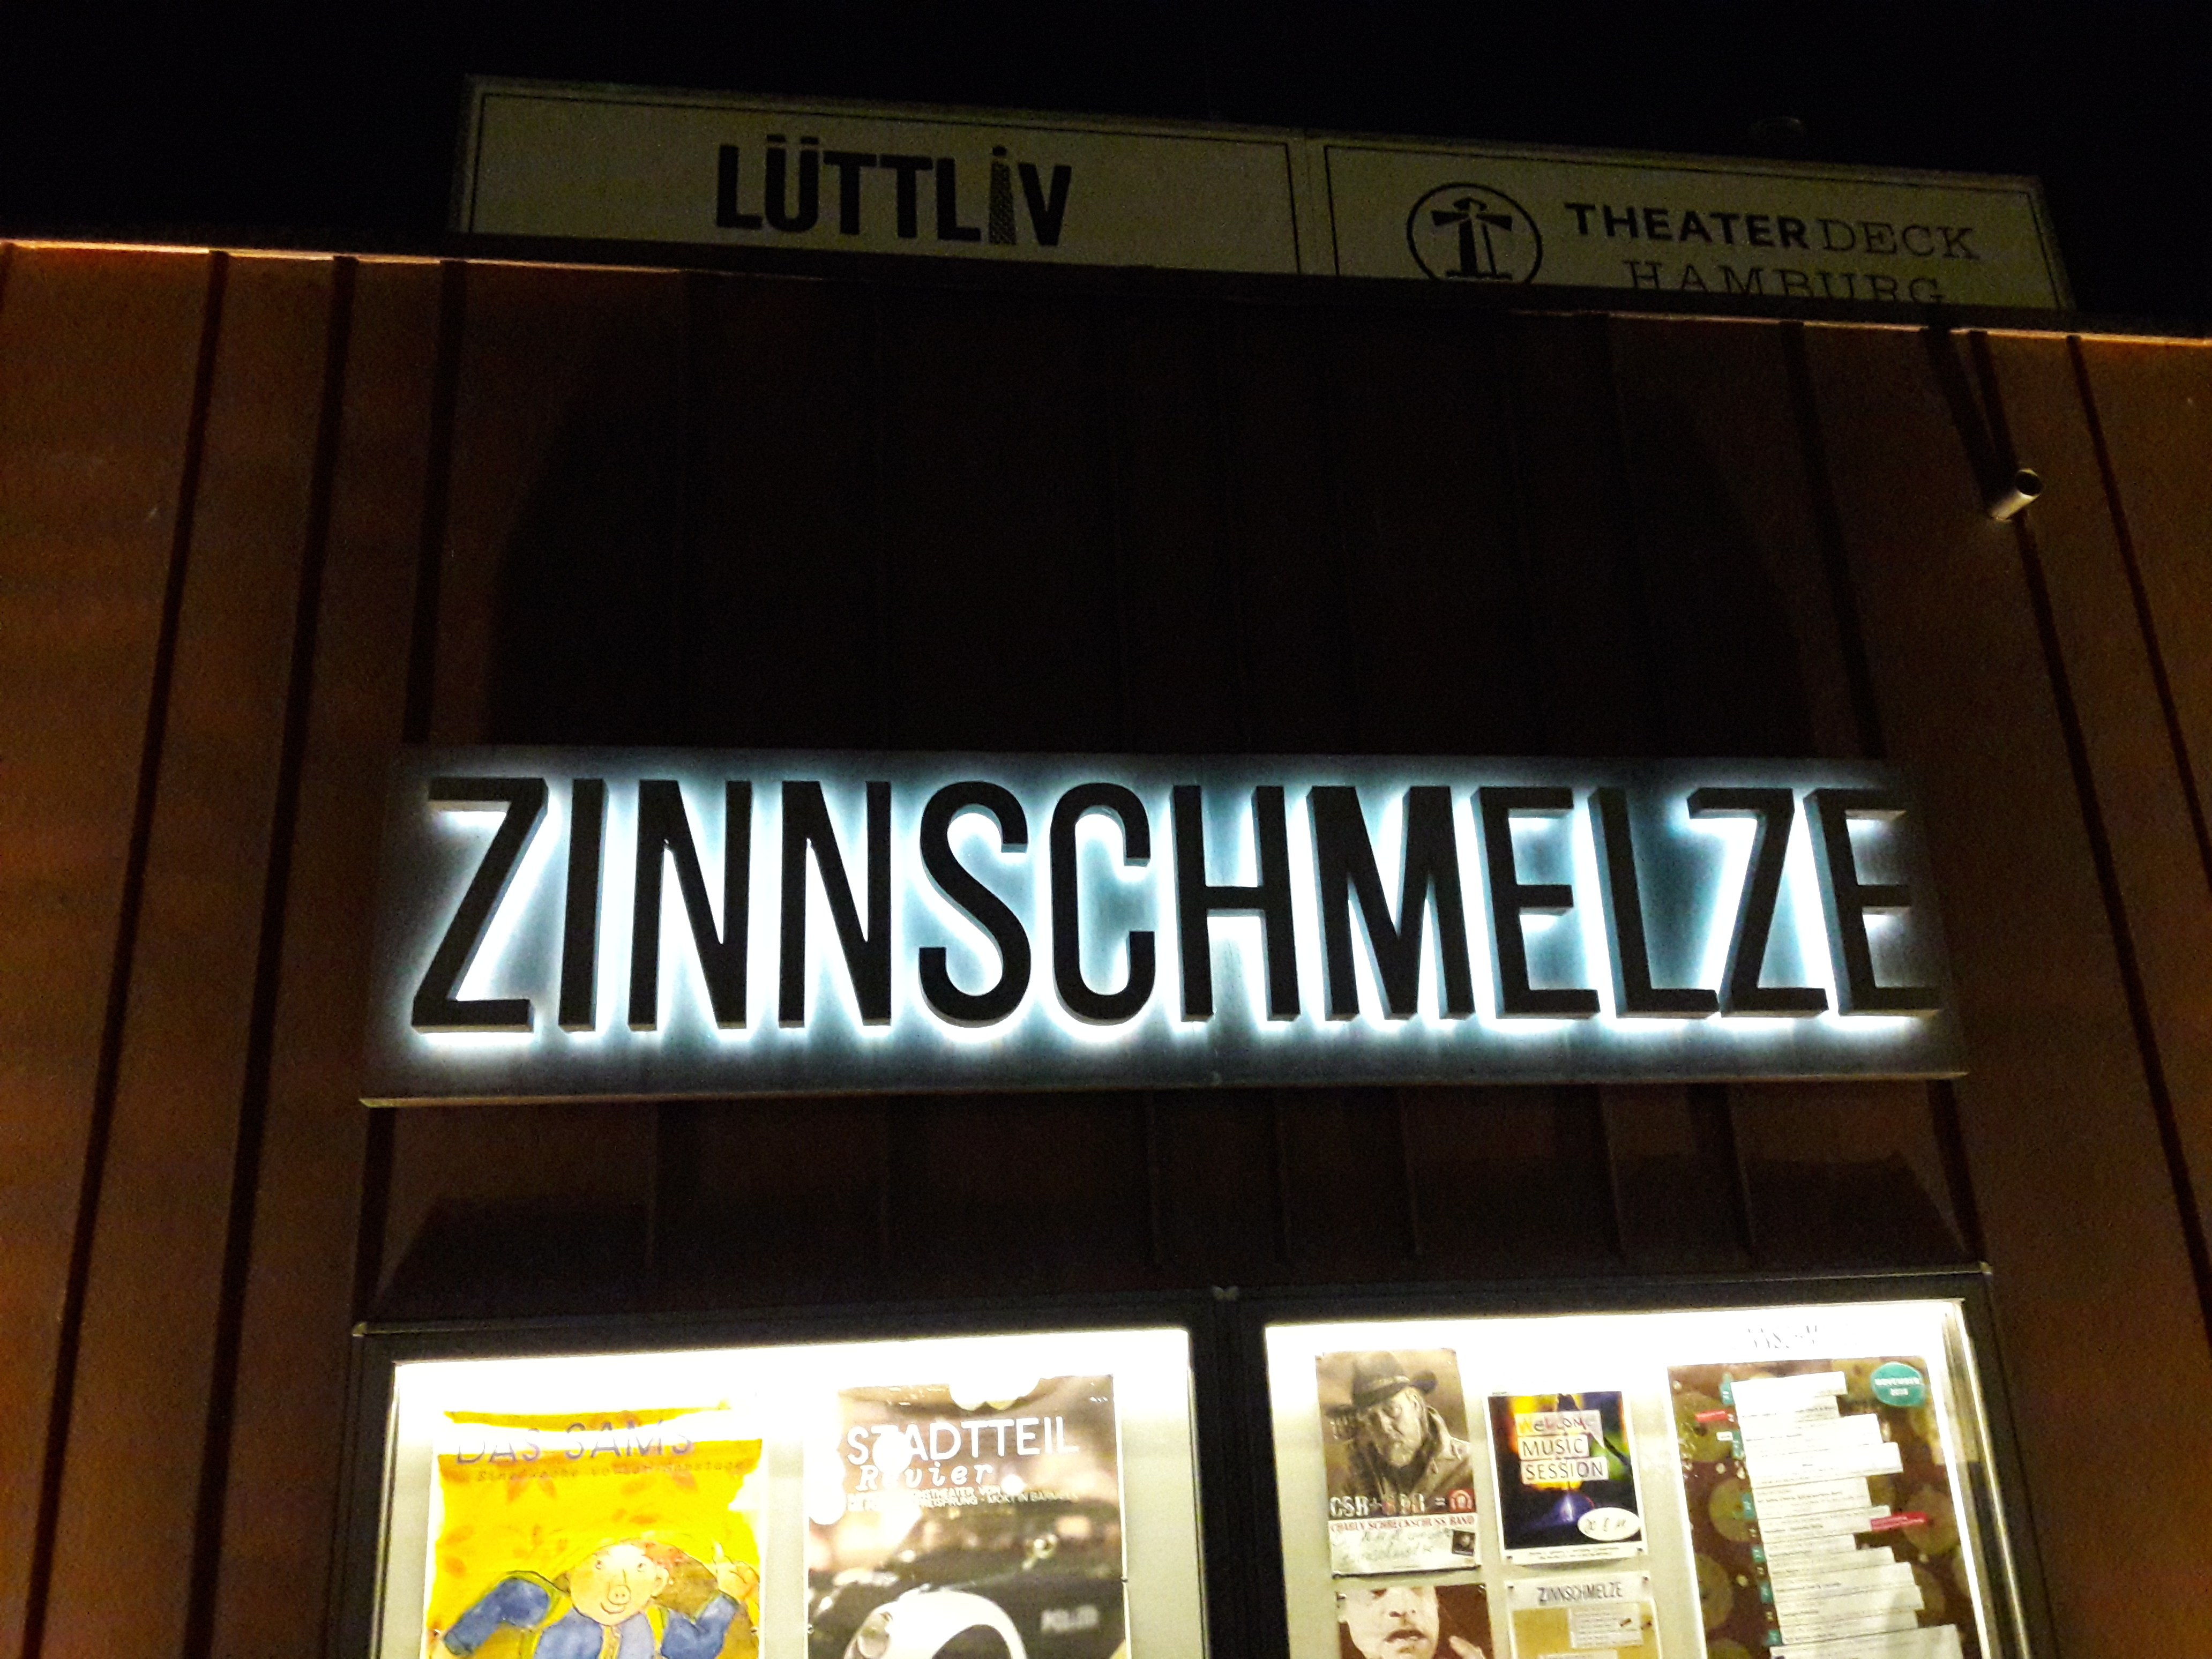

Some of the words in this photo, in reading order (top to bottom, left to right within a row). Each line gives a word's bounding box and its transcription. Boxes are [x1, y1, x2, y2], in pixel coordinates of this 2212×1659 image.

[1621, 259, 1947, 305] HAMBURG
[410, 776, 1942, 1034] ZINNSCHMELZE
[1522, 1438, 1583, 1457] MUSIC
[1525, 1461, 1604, 1480] SESSION
